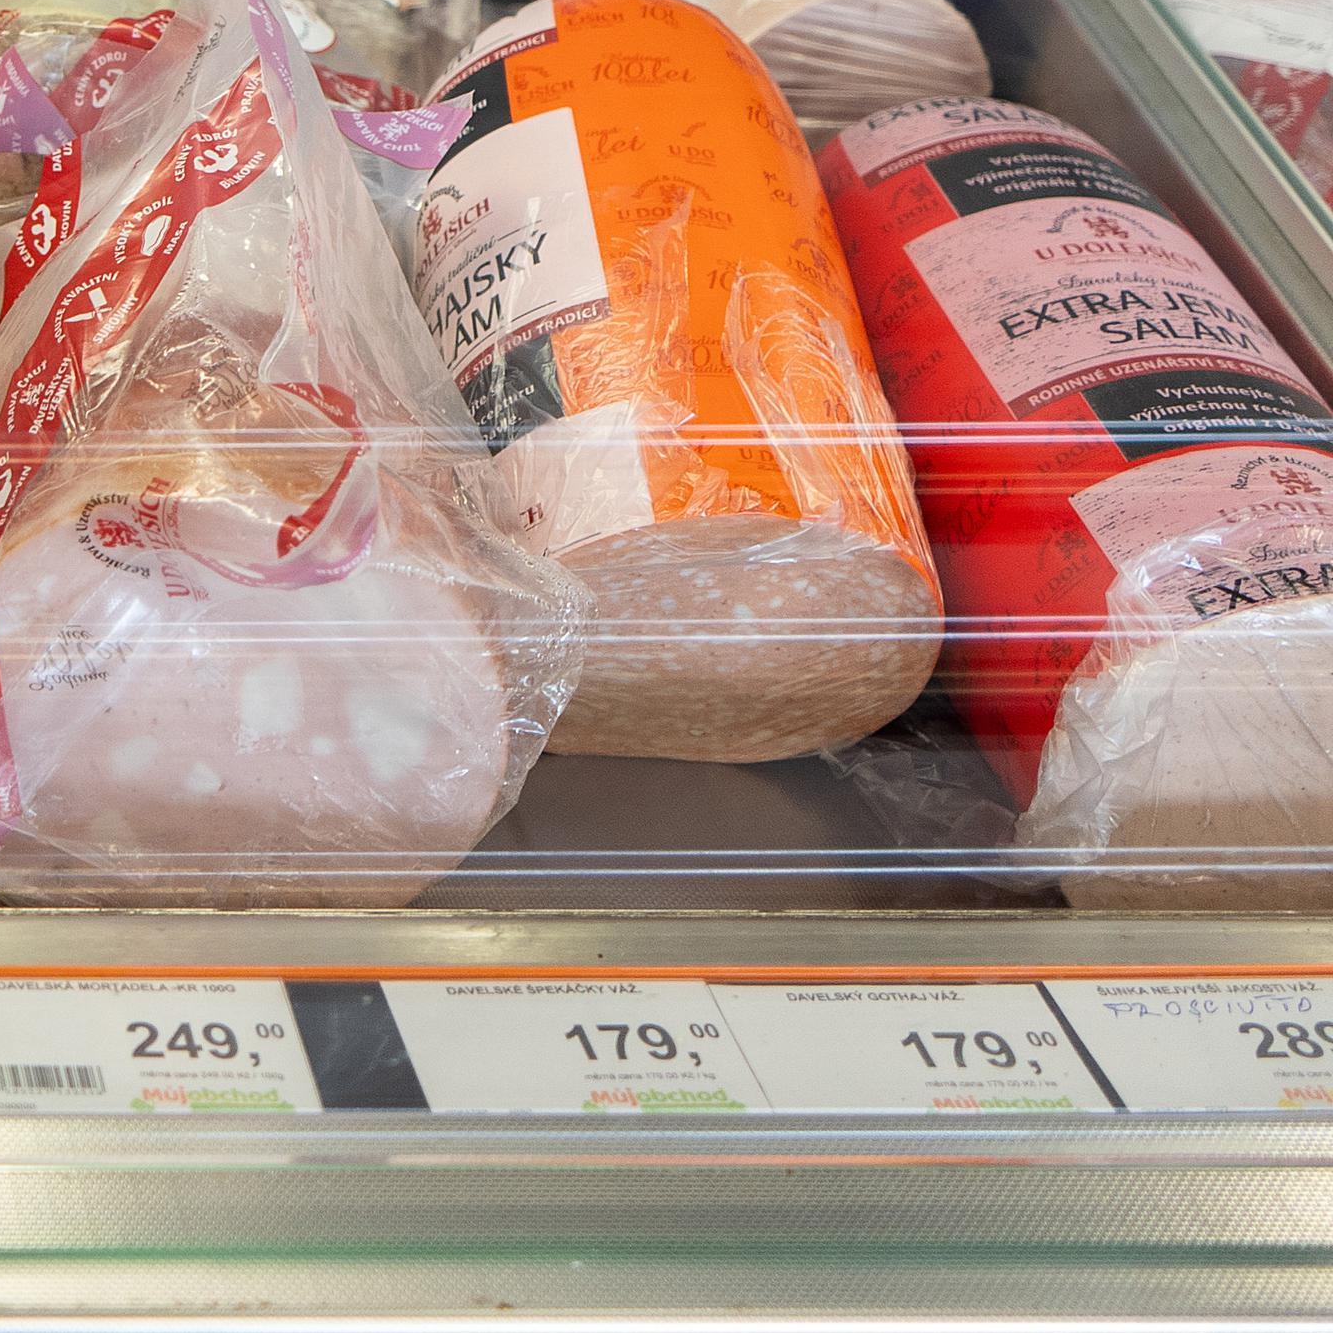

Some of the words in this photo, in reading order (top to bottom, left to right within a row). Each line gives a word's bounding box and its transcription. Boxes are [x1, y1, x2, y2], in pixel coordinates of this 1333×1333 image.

[90, 51, 127, 71] ZDROJ
[492, 32, 547, 59] TRADICÍ
[174, 143, 193, 183] CENNÝ
[190, 128, 238, 143] ZDROJ
[219, 150, 267, 191] BÍLKOVIN
[992, 177, 1077, 195] originálu
[115, 219, 137, 264] VYSOKÝ
[132, 195, 175, 223] PODÍL
[163, 220, 189, 256] MASA
[1034, 247, 1056, 262] U
[62, 270, 120, 307] KVALITNÍ
[428, 229, 548, 336] HAJSKÝ
[92, 294, 140, 345] SUROVINY
[998, 289, 1153, 341] EXTRA
[1099, 318, 1262, 355] SALÁM
[28, 356, 73, 436] DAVELSKÝCH
[45, 372, 75, 423] UZENIN
[1027, 368, 1106, 408] RODINNÉ
[1108, 356, 1216, 378] UZENÁŘSTVÍ
[1155, 385, 1275, 401] Vychutnejte
[1128, 398, 1247, 423] výjimečnou
[1163, 415, 1256, 434] originálu
[1268, 454, 1280, 463] &
[78, 980, 169, 993] MORTADELA
[445, 983, 524, 996] DAVELSKÉ
[526, 982, 605, 995] ŠPEKÁČKY
[785, 990, 864, 1003] DAVELSKÝ
[1096, 983, 1148, 997] ŠUNKA
[1149, 983, 1221, 996] NEJVYŠŠÍ
